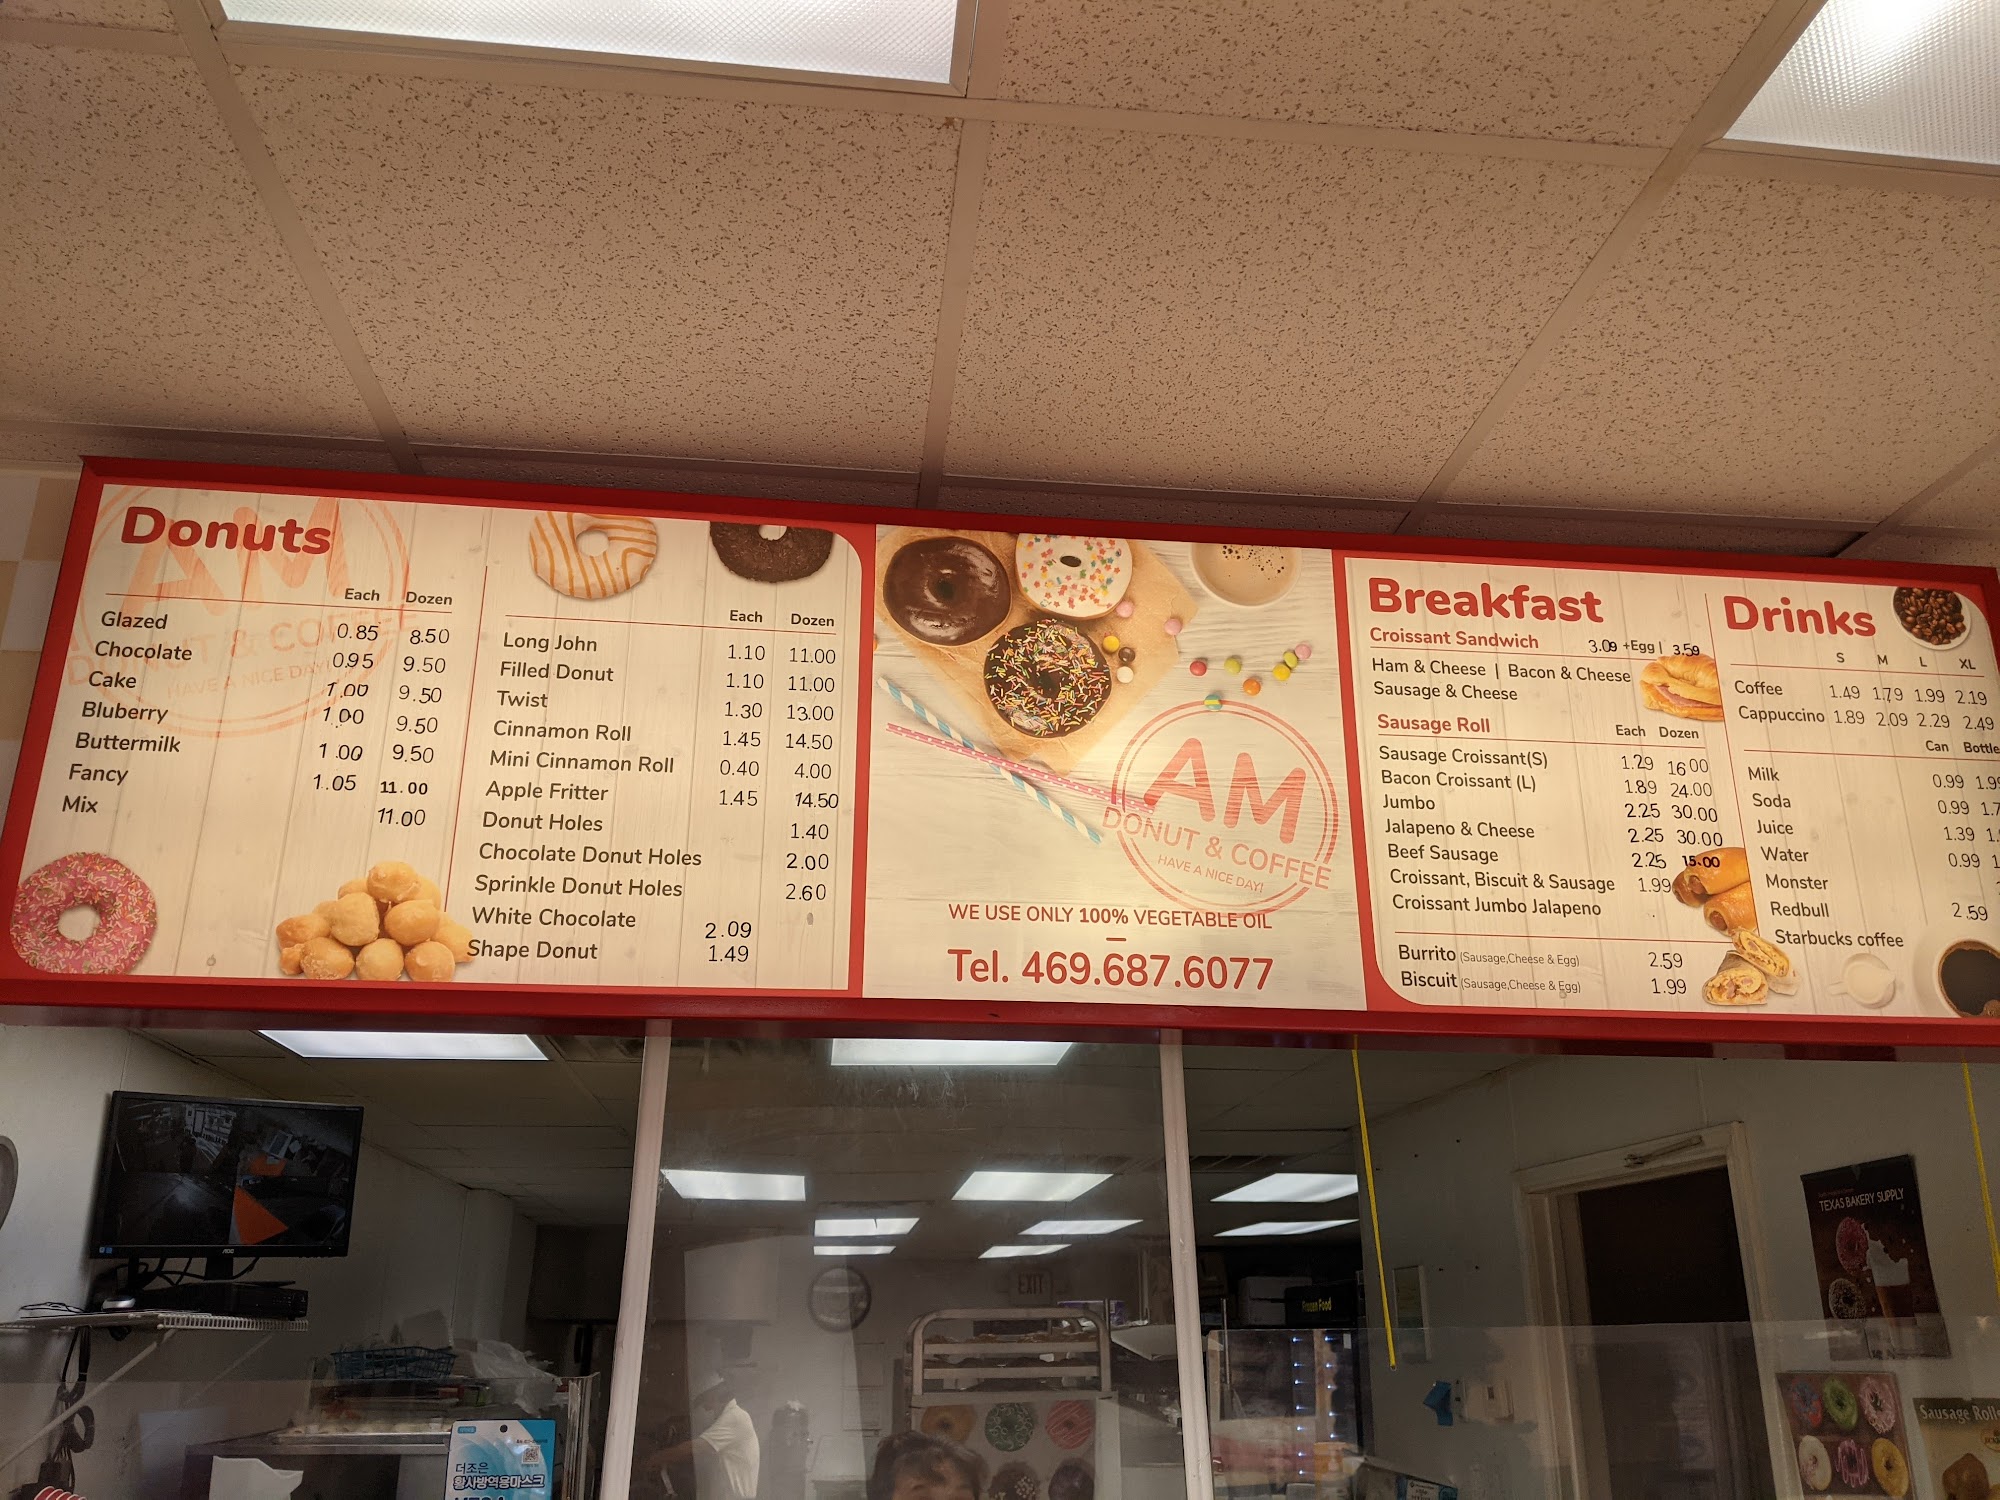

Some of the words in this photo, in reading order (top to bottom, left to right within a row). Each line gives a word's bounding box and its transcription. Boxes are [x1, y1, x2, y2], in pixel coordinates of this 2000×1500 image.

[121, 506, 331, 555] Donuts
[344, 588, 380, 602] Each
[405, 591, 452, 606] Dozen
[1369, 577, 1603, 623] Breakfast
[101, 611, 167, 630] Glazed
[337, 623, 379, 641] 0.85
[410, 629, 450, 644] 8.50
[729, 610, 763, 623] Each
[791, 613, 834, 627] Dozen
[1724, 596, 1876, 637] Drinks
[503, 632, 549, 653] Long
[554, 635, 597, 652] John
[728, 644, 766, 661] 1.10
[789, 647, 836, 664] 11.00
[1370, 627, 1451, 645] Croissant
[1456, 631, 1539, 648] Sandwich
[1623, 640, 1655, 653] +Egg
[95, 641, 193, 661] Chocolate
[333, 652, 374, 668] 0.95
[403, 656, 446, 673] 9.50
[88, 671, 137, 689] Cake
[500, 662, 549, 679] Filled
[556, 665, 613, 681] Donut
[726, 673, 764, 689] 1.10
[788, 675, 835, 693] 11.00
[1372, 658, 1408, 672] Ham
[1430, 660, 1486, 676] Cheese
[1509, 664, 1555, 679] Bacon
[1576, 667, 1631, 682] Cheese
[1373, 681, 1440, 699] Sausage
[1461, 685, 1518, 700] Cheese
[1734, 680, 1783, 695] Coffee
[1829, 684, 1860, 699] 1.49
[1914, 688, 1944, 703] 1.99
[1955, 690, 1987, 705] 2.19
[82, 701, 168, 723] Bluberry
[396, 716, 438, 734] 9.50
[497, 691, 548, 708] Twist
[724, 702, 763, 718] 1.30
[787, 704, 834, 722] 13.00
[1738, 706, 1824, 724] Cappuccino
[1834, 710, 1865, 724] 1.89
[1876, 712, 1908, 727] 2.09
[1917, 713, 1950, 728] 2.29
[1963, 716, 1994, 731] 2.49
[493, 721, 589, 740] Cinnamon
[596, 725, 631, 741] Roll
[723, 731, 761, 747] 1.45
[785, 733, 833, 750] 14.50
[1377, 714, 1451, 733] Sausage
[1457, 718, 1490, 733] Roll
[1616, 725, 1646, 737] Each
[1659, 727, 1699, 739] Dozen
[75, 732, 180, 754] Buttermilk
[393, 744, 434, 763] 9.50
[1379, 746, 1446, 764] Sausage
[1452, 749, 1548, 769] Croissant(S)
[1925, 740, 1949, 752] Can
[1964, 742, 2000, 754] Bottle
[69, 764, 128, 785] Fancy
[490, 751, 529, 768] Mini
[536, 753, 631, 771] Cinnamon
[638, 757, 674, 773] Roll
[720, 760, 760, 777] 0.40
[794, 763, 832, 779] 4.00
[1143, 737, 1307, 844] AM
[1381, 770, 1431, 787] Bacon
[1436, 772, 1511, 789] Croissant
[1748, 767, 1779, 781] Milk
[1932, 774, 1964, 789] 0.99
[485, 781, 543, 801] Apple
[550, 783, 608, 801] Fritter
[719, 790, 758, 806] 1.45
[1752, 793, 1791, 808] Soda
[1938, 800, 1969, 815] 0.99
[62, 796, 98, 814] Mix
[378, 808, 425, 826] 11.00
[1383, 795, 1435, 810] Jumbo
[1625, 803, 1660, 818] 2.25
[1672, 805, 1717, 822] 30.00
[482, 812, 543, 830] Donut
[549, 814, 603, 831] Holes
[790, 823, 829, 840] 1.40
[1385, 819, 1455, 836] Jalapeno
[1477, 823, 1535, 838] Cheese
[1628, 828, 1664, 842] 2.25
[1677, 830, 1722, 846] 30.00
[1757, 820, 1794, 835] Juice
[1943, 827, 1975, 841] 1.39
[479, 844, 576, 863] Chocolate
[583, 846, 642, 864] Donut
[649, 849, 702, 866] Holes
[786, 853, 829, 871] 2.00
[1101, 805, 1200, 851] DONUT
[1231, 843, 1331, 890] COFFEE
[1388, 844, 1424, 858] Beef
[1430, 846, 1498, 862] Sausage
[1761, 847, 1809, 862] Water
[1948, 853, 1980, 868] 0.99
[1158, 854, 1191, 873] HAVE
[1193, 863, 1202, 875] A
[1206, 866, 1234, 885] NICE
[1236, 875, 1264, 893] DAY!
[1390, 870, 1470, 888] Croissant,
[1475, 872, 1529, 888] Biscuit
[1549, 875, 1615, 892] Sausage
[1765, 874, 1828, 890] Monster
[475, 875, 555, 895] Sprinkle
[563, 878, 622, 895] Donut
[628, 880, 683, 897] Holes
[785, 883, 826, 901] 2.60
[948, 904, 979, 920] WE
[985, 905, 1020, 921] USE
[1026, 907, 1073, 923] ONLY
[1079, 907, 1129, 924] 100%
[1134, 910, 1237, 928] VEGETABLE
[1243, 913, 1273, 929] OIL
[1392, 895, 1470, 912] Croissant
[1474, 897, 1527, 913] Jumbo
[1532, 900, 1601, 917] Jalapeno
[1771, 902, 1829, 917] Redbull
[1951, 902, 1988, 921] 2.59
[472, 907, 532, 925] White
[539, 909, 636, 927] Chocolate
[705, 921, 752, 939] 2.09
[467, 940, 529, 961] Shape
[536, 942, 597, 959] Donut
[708, 945, 749, 962] 1.49
[1775, 930, 1852, 946] Starbucks
[1857, 933, 1903, 947] coffee
[1398, 944, 1456, 962] Burrito
[1460, 951, 1544, 965] (Sausage,Cheese
[1557, 955, 1580, 967] Egg)
[1648, 952, 1683, 969] 2.59
[948, 949, 1008, 983] Tel.
[1022, 952, 1274, 990] 469.687.6077
[1401, 972, 1457, 988] Biscuit
[1461, 978, 1545, 991] (Sausage,Cheese
[1558, 981, 1581, 993] Egg)
[1651, 978, 1687, 995] 1.99
[1819, 1198, 1845, 1211] TEXAS
[1846, 1193, 1875, 1207] BAKERY
[1877, 1188, 1904, 1202] SUPPLY
[1319, 1297, 1331, 1311] Food
[1920, 1405, 1969, 1424] Sausage
[456, 1462, 489, 1474] 더조은
[453, 1474, 544, 1490] 황사방역용마스크
